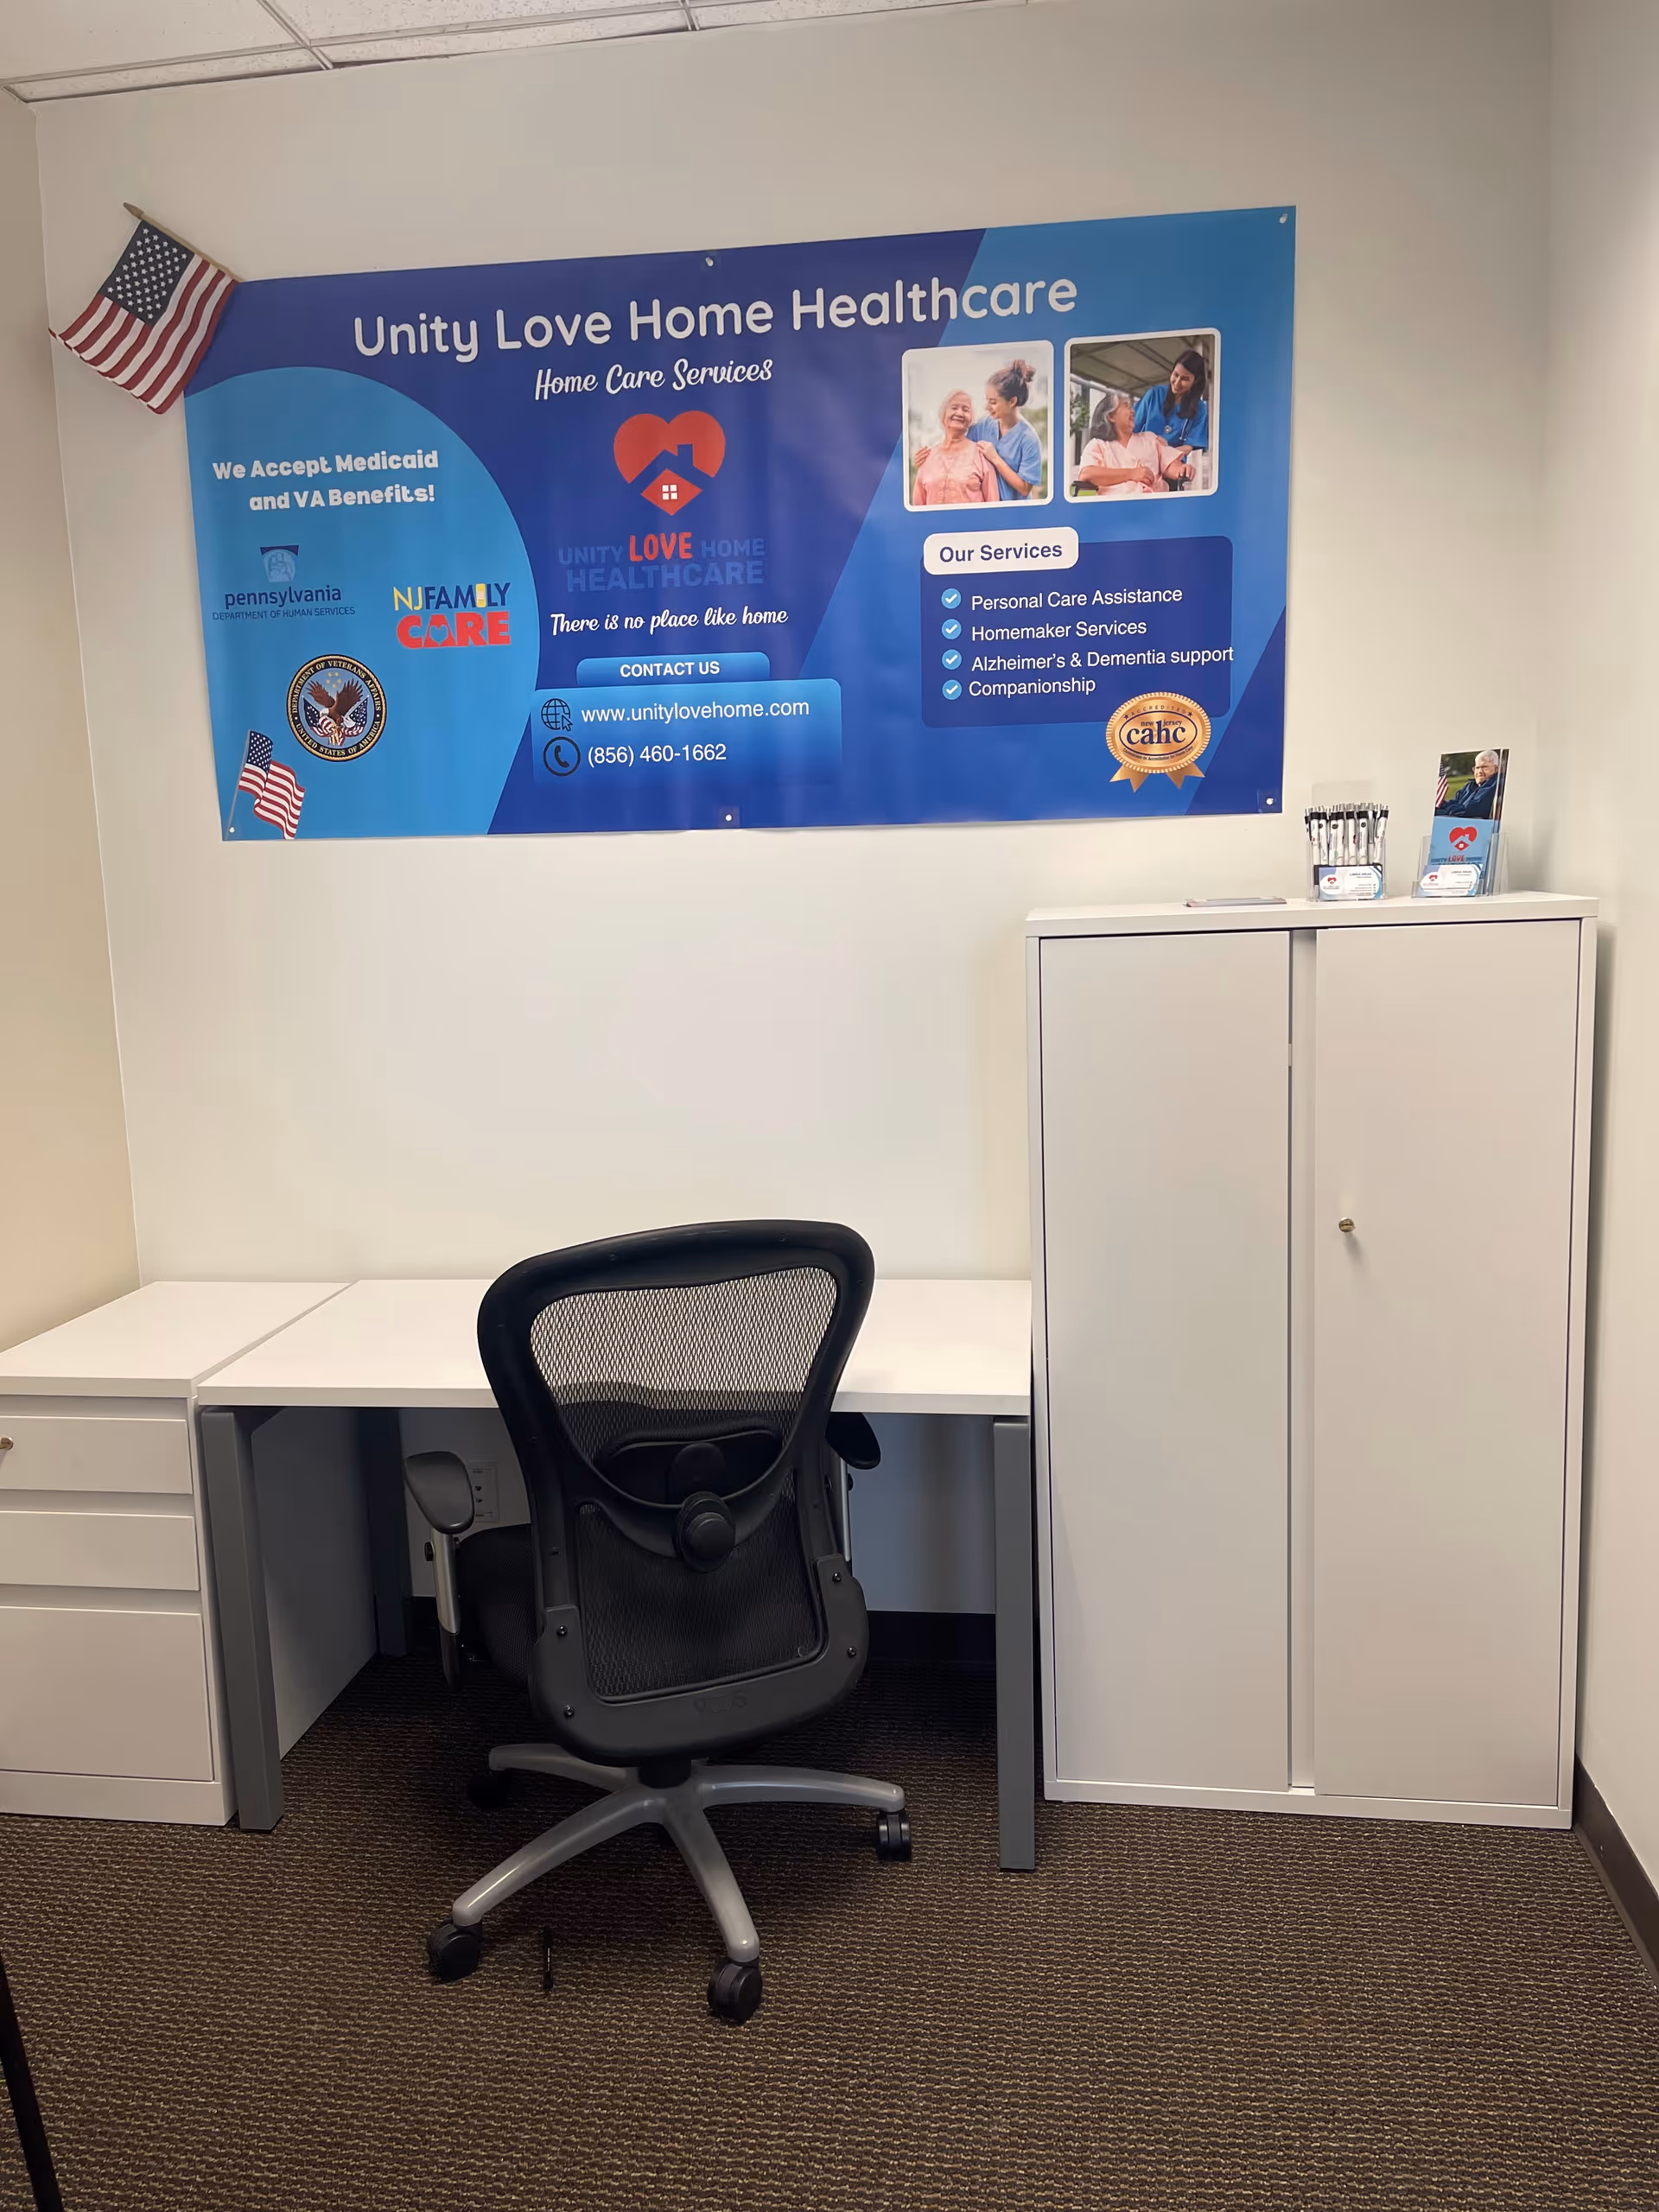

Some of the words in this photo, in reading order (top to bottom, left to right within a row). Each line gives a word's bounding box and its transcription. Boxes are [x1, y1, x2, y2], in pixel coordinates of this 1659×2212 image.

[354, 312, 477, 363] Unity
[496, 308, 612, 349] Love
[629, 298, 773, 341] Home
[792, 276, 1078, 331] Healthcare
[535, 367, 598, 401] Home
[606, 363, 665, 395] Care
[672, 359, 773, 391] Services
[213, 461, 246, 480] We
[251, 455, 333, 478] Accept
[335, 449, 439, 473] Medicaid
[249, 491, 289, 511] and
[294, 489, 326, 508] VA
[328, 484, 435, 507] Benefits!
[557, 545, 624, 565] UNITY
[629, 531, 693, 562] LOVE
[701, 537, 766, 558] HOME
[939, 546, 975, 563] Our
[980, 543, 1063, 562] Services
[566, 559, 766, 594] HEALTHCARE
[225, 584, 342, 610] pennsylvania
[971, 591, 1043, 611] Personal
[1047, 590, 1087, 608] Care
[1091, 587, 1183, 607] Assistance
[213, 610, 268, 620] DEPARTMENT
[270, 609, 281, 619] OF
[283, 607, 313, 618] HUMAN
[315, 606, 356, 616] SERVICES
[550, 612, 600, 636] There
[604, 613, 619, 632] is
[624, 615, 645, 631] no
[650, 608, 699, 635] place
[703, 606, 738, 626] like
[741, 605, 789, 626] home
[396, 611, 512, 650] CARE
[971, 622, 1072, 642] Homemaker
[1076, 619, 1147, 638] Services
[620, 661, 696, 678] CONTACT
[698, 660, 721, 676] US
[1070, 652, 1083, 668] &
[1087, 648, 1166, 668] Dementia
[1170, 645, 1234, 667] support
[292, 667, 315, 714] DEPARTMENT
[315, 661, 326, 671] OF
[327, 660, 366, 680] VETERANS
[365, 677, 381, 711] AFFAIRS
[969, 677, 1096, 699] Companionship
[581, 700, 810, 725] www.unitylovehome.com
[1131, 704, 1187, 716] ACCREDITED
[296, 722, 318, 749] UNITED
[320, 746, 346, 757] STATES
[348, 746, 358, 754] OF
[359, 721, 380, 749] AMERICA
[1126, 720, 1186, 746] cahc
[588, 745, 635, 767] (856)
[639, 743, 727, 764] 460-1662
